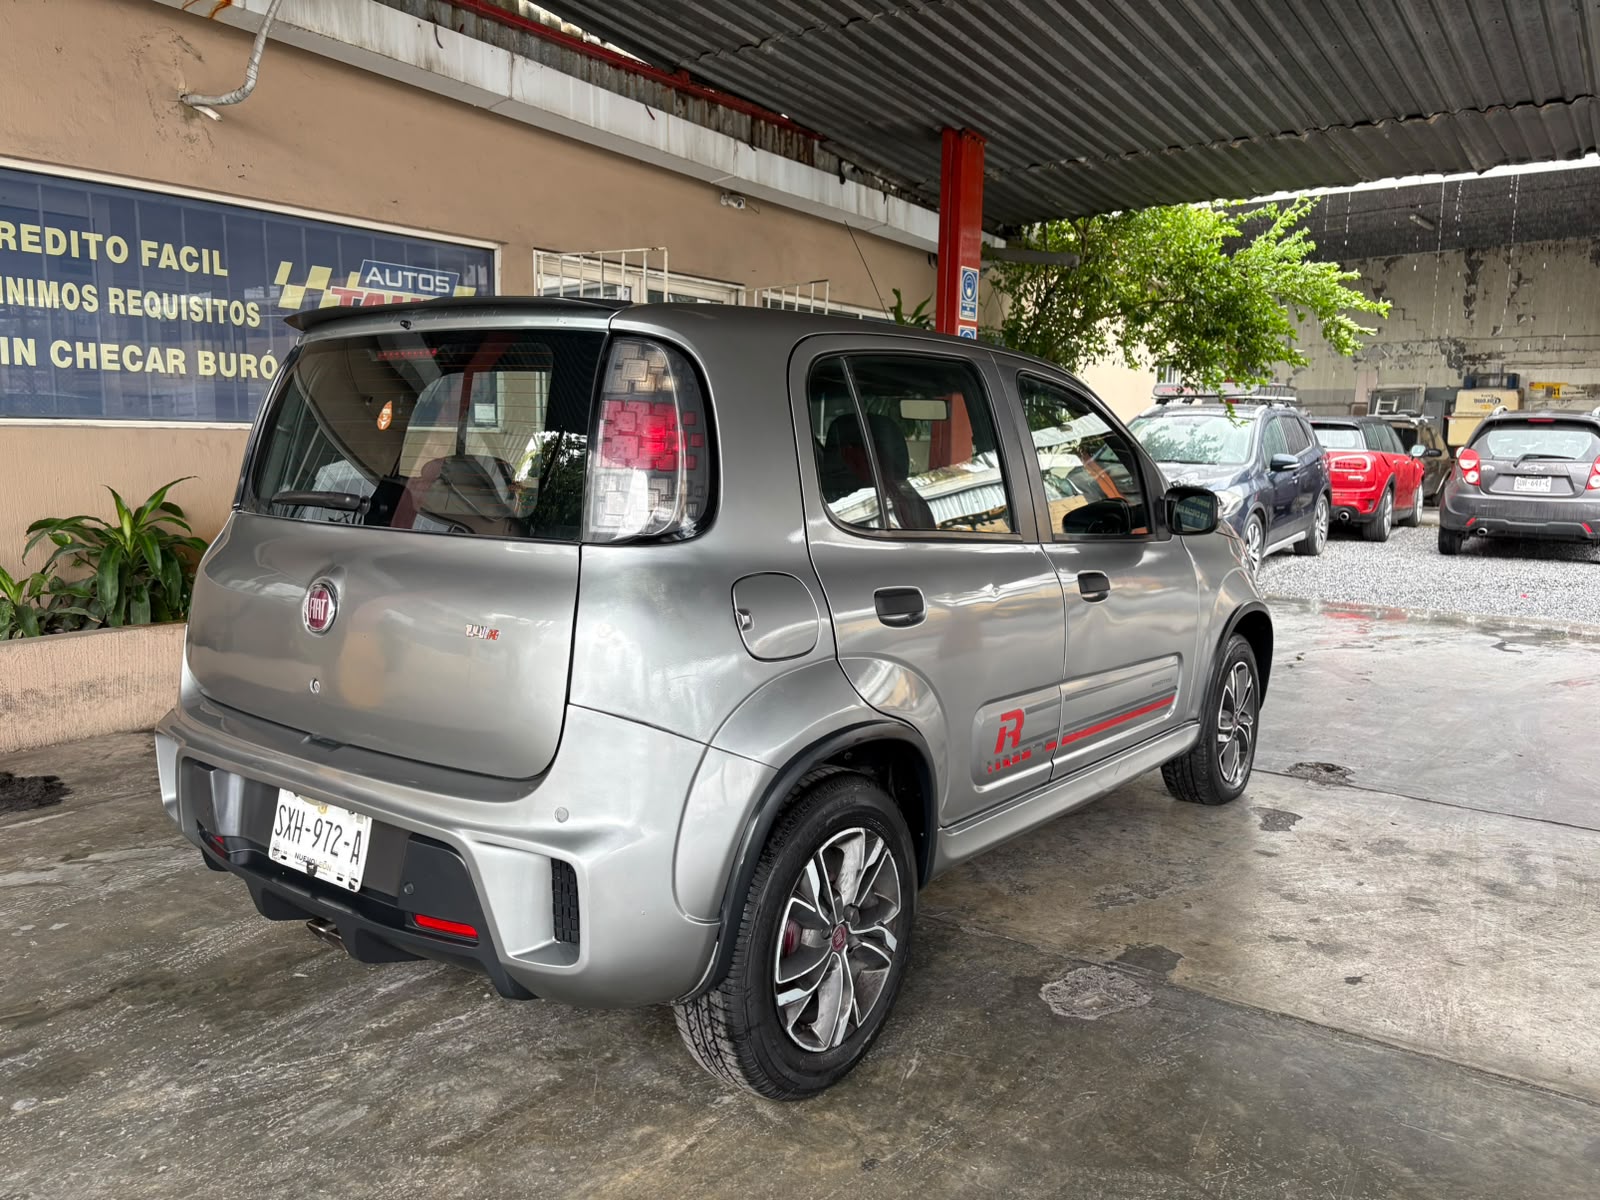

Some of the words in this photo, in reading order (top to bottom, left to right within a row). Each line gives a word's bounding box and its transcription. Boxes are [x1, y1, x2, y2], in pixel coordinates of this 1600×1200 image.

[0, 220, 129, 264] REDITO
[141, 239, 228, 277] FACIL
[365, 266, 450, 293] AUTOS
[108, 287, 261, 328] REQUISITOS
[50, 340, 187, 375] CHECAR
[197, 349, 279, 380] BURÓ
[310, 597, 327, 621] FIAT
[275, 804, 362, 866] SXH-972-A
